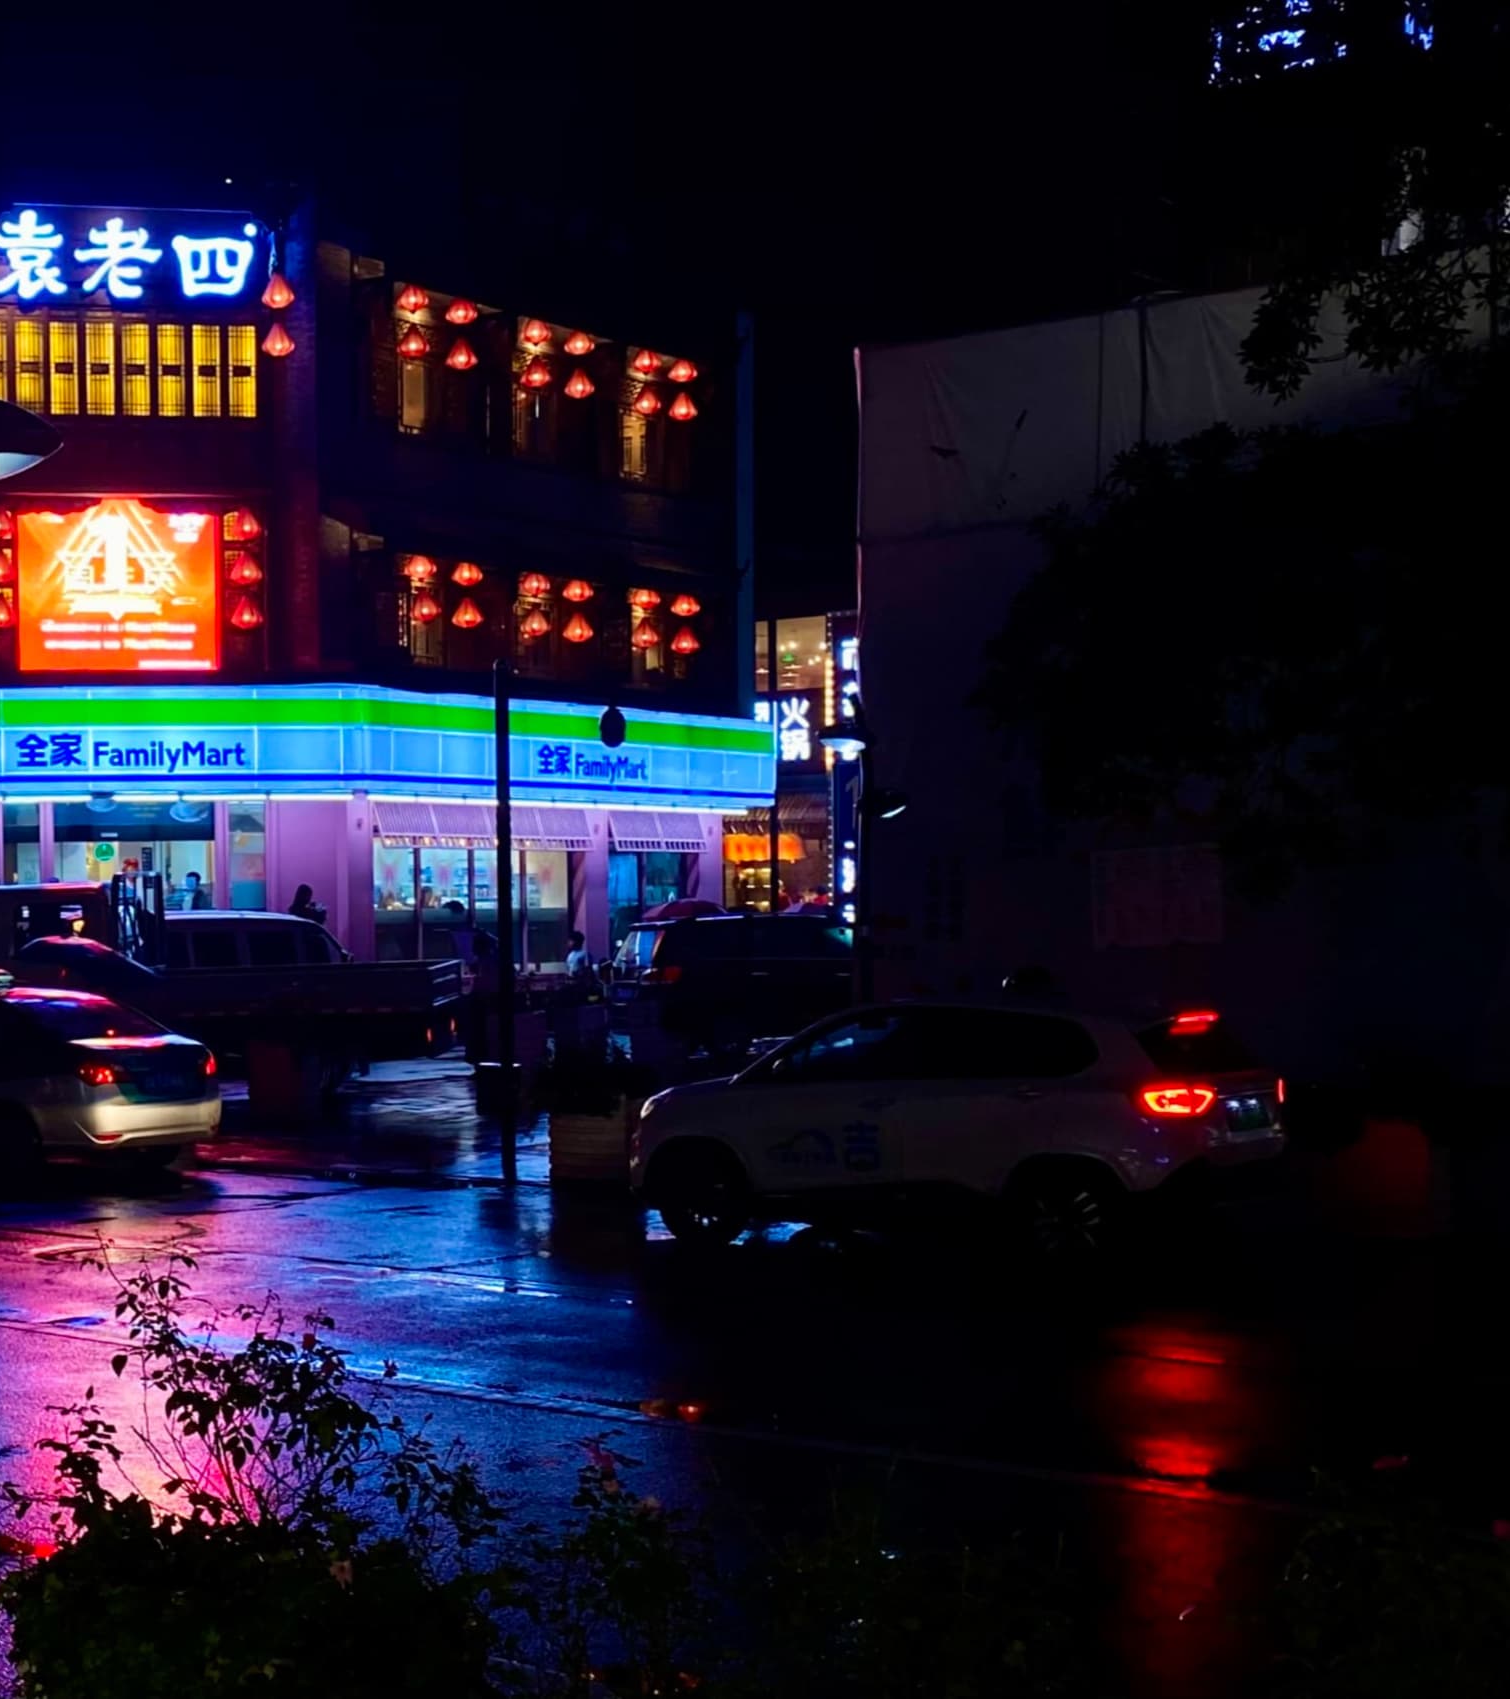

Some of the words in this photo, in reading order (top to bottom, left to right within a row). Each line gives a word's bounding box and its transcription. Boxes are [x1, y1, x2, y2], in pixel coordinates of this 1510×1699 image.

[16, 733, 83, 767] 全家
[93, 740, 247, 773] FamilyMart
[537, 744, 571, 775] 全家
[575, 753, 648, 783] FamilyMart
